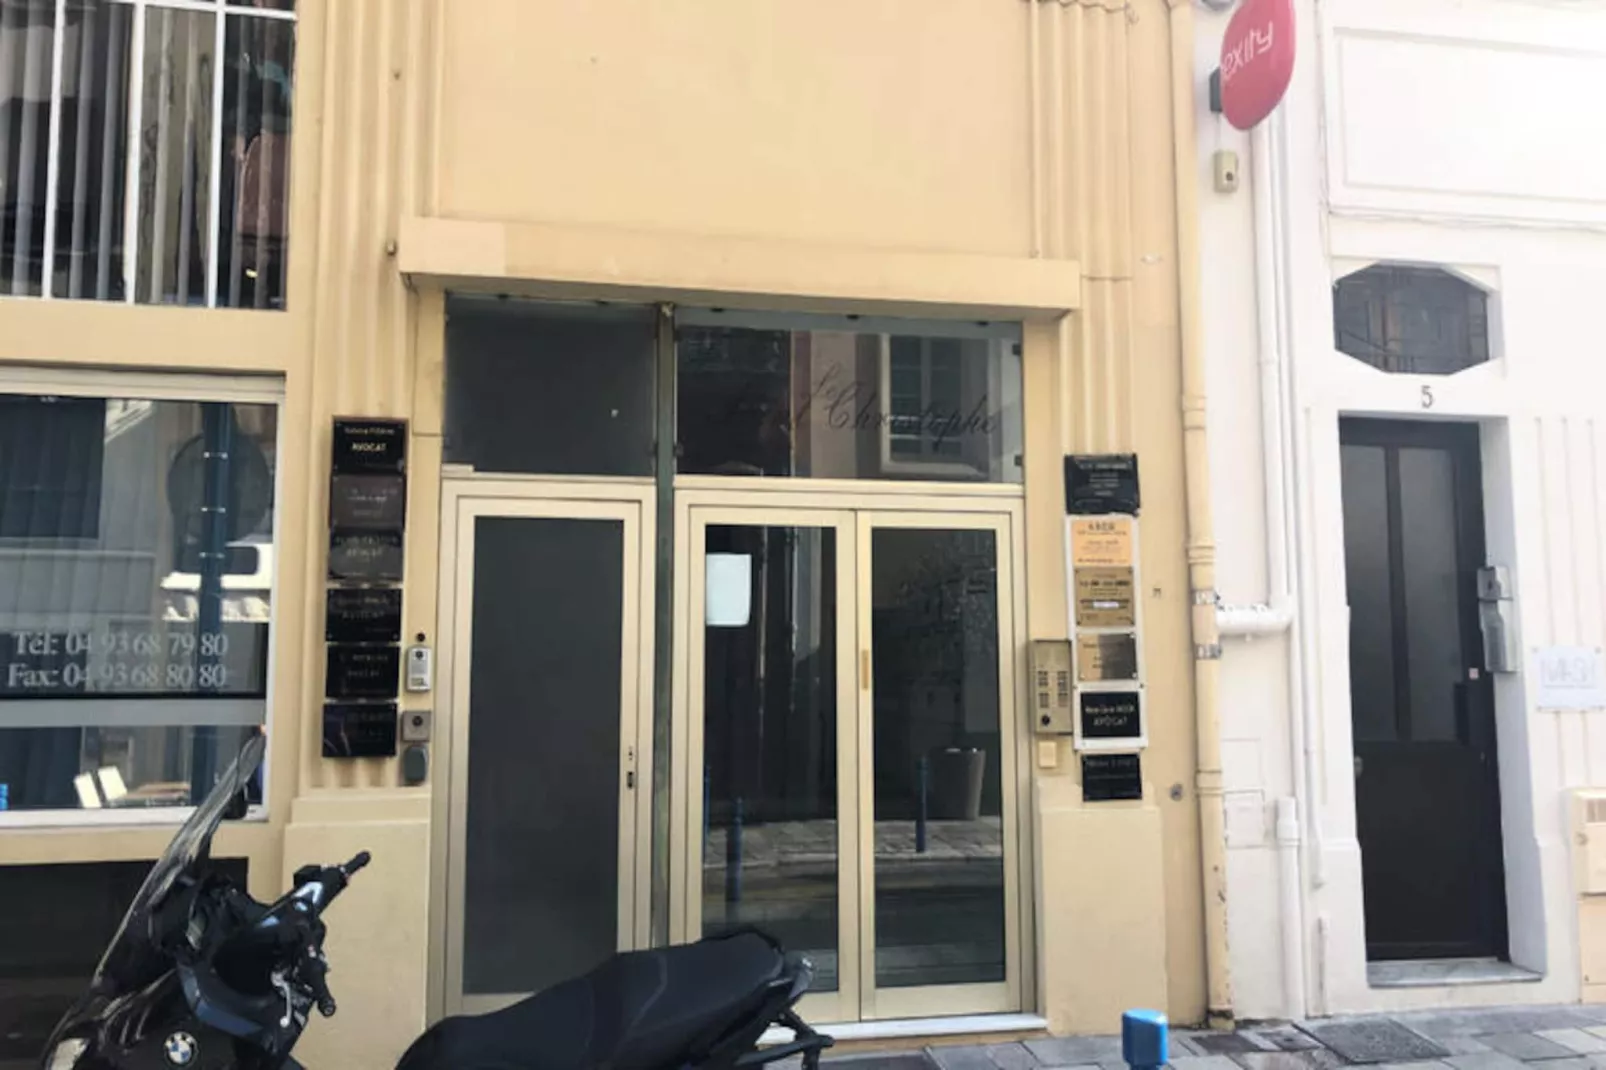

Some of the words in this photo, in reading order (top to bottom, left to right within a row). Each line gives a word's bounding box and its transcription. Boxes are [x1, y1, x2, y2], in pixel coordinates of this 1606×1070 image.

[1420, 385, 1434, 410] 5
[351, 442, 387, 453] AVOCAT
[65, 630, 92, 656] 04
[100, 631, 129, 656] 93
[133, 632, 162, 656] 68
[167, 632, 195, 656] 79
[201, 632, 229, 656] 80
[8, 662, 59, 688] Fax:
[63, 662, 91, 688] 04
[99, 661, 128, 687] 93
[131, 663, 159, 687] 68
[166, 663, 194, 688] 80
[199, 663, 227, 688] 80
